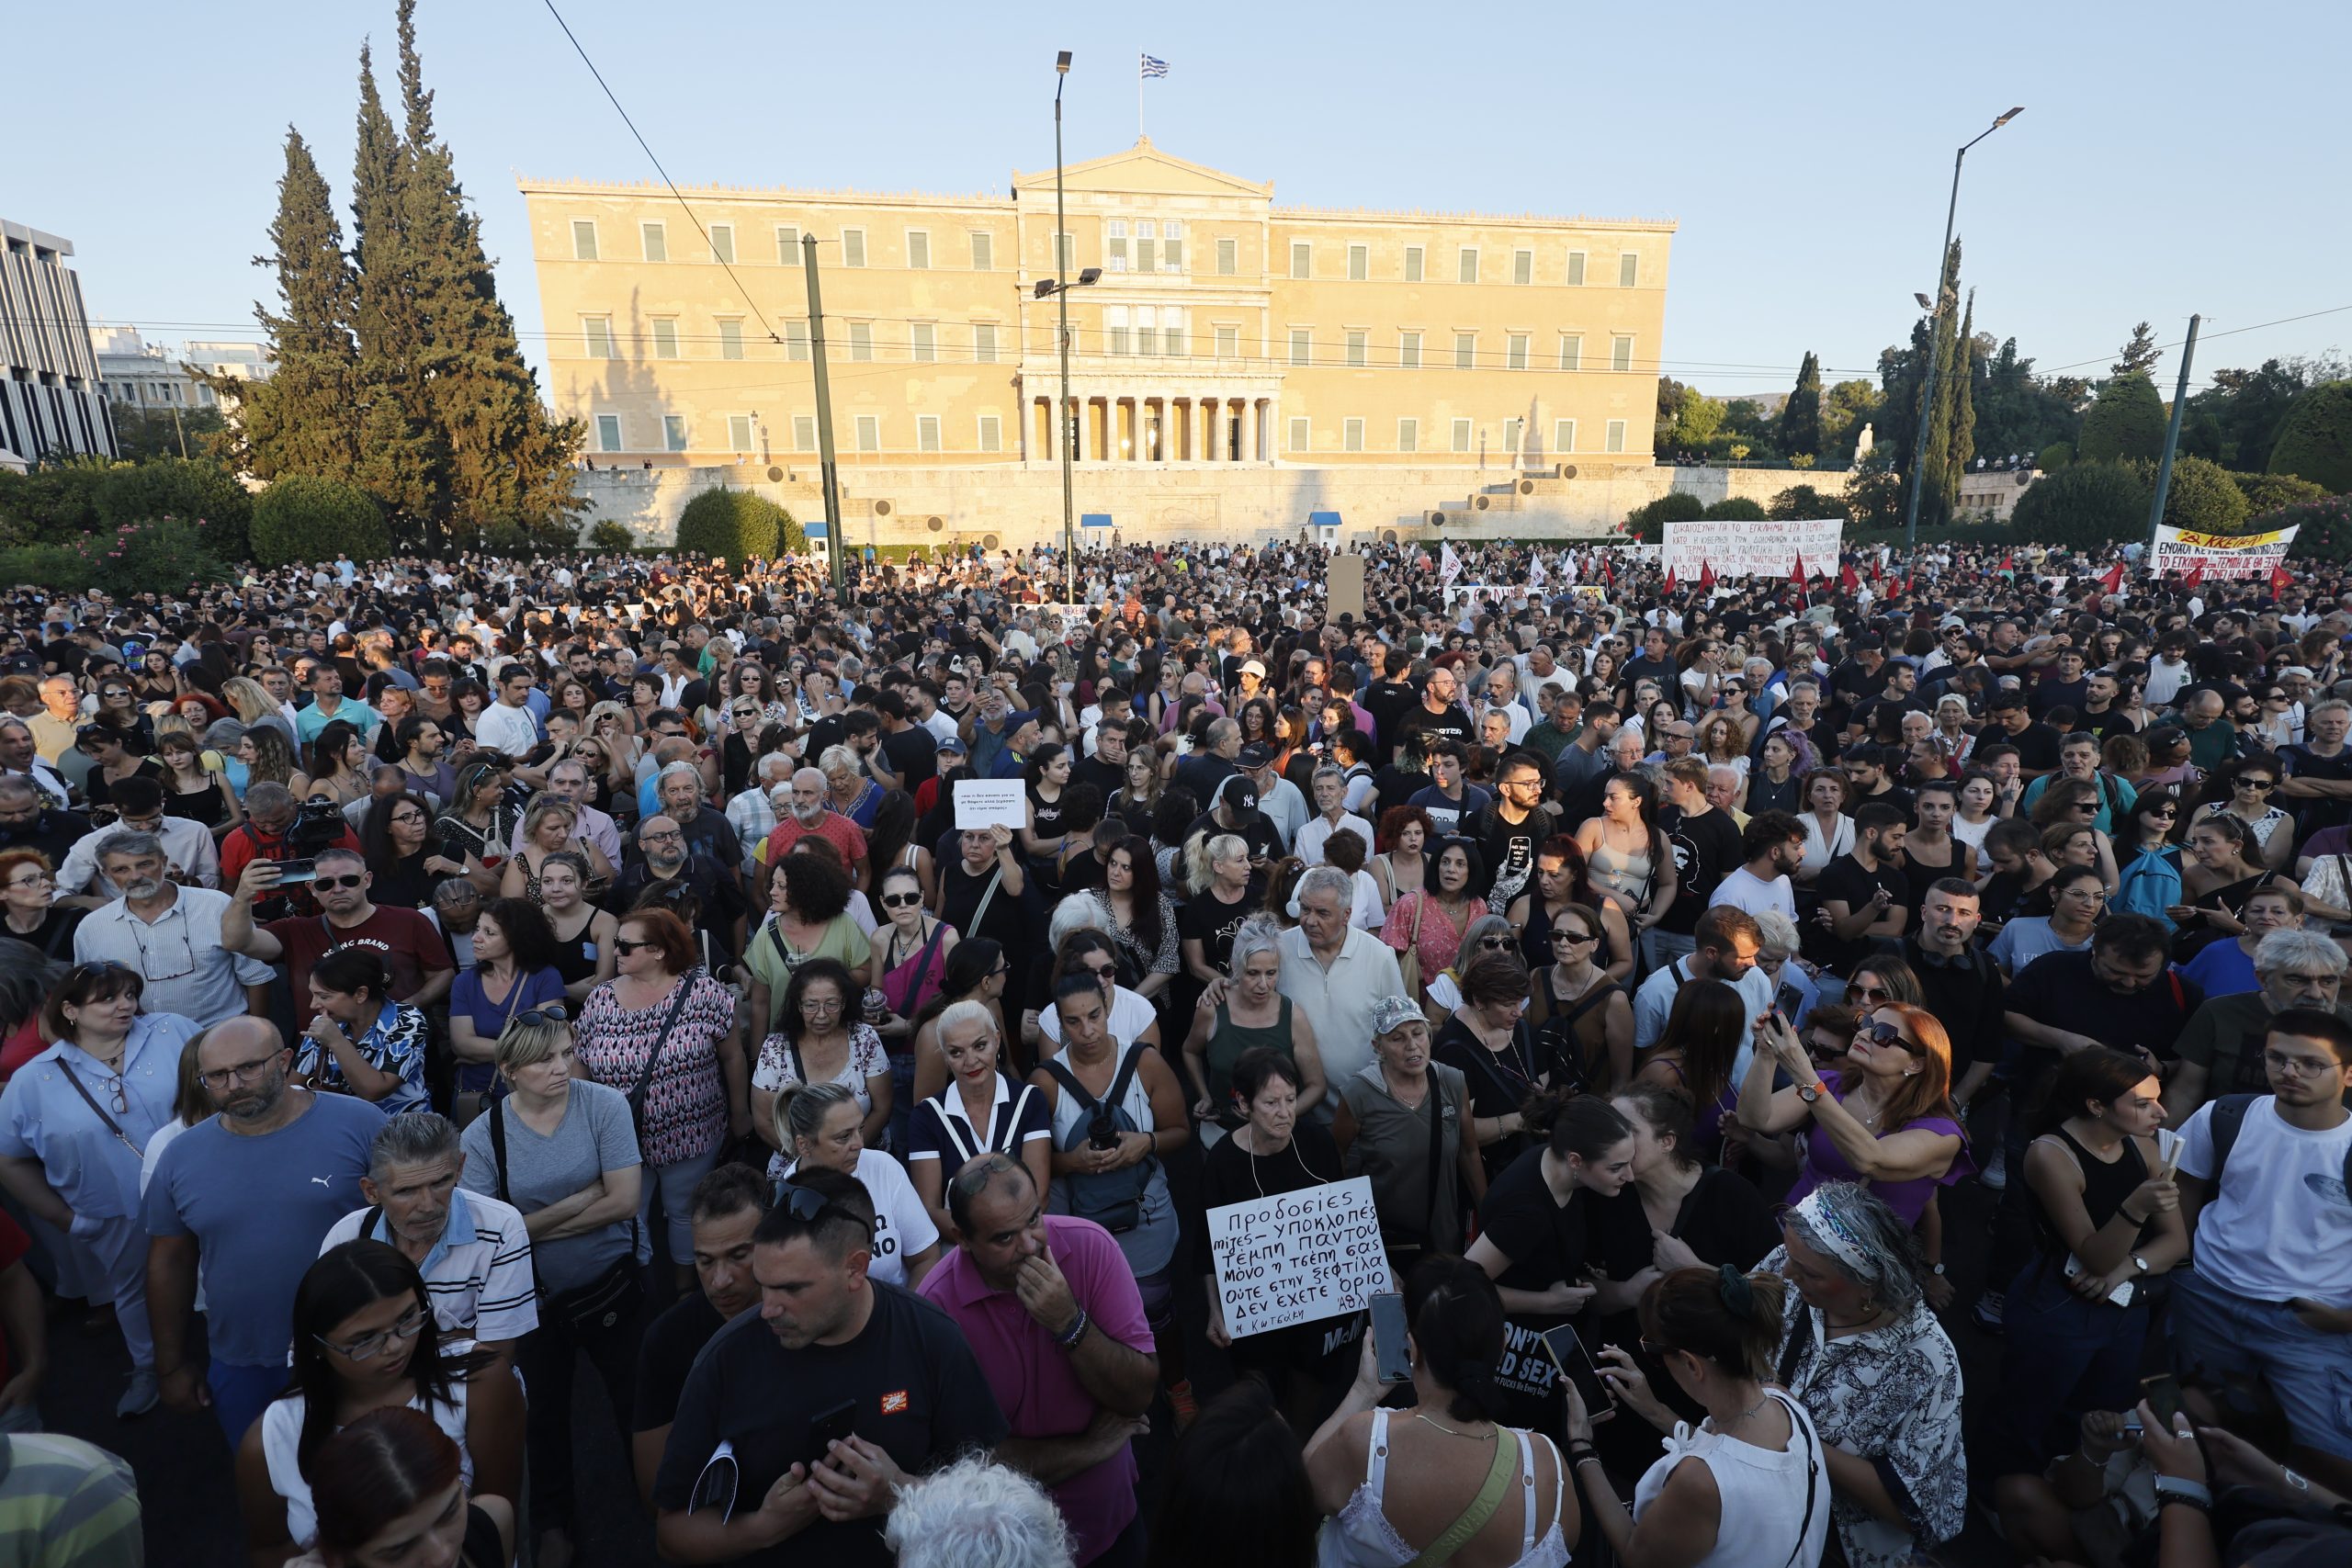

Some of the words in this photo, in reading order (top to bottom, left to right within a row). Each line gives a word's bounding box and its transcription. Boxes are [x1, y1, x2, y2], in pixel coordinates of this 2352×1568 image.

[1673, 524, 1715, 534] ΔΙΚΑΙΟΣΥΝΗ
[1719, 524, 1727, 532] ΓΙΑ
[1732, 524, 1741, 532] ΤΟ
[1749, 523, 1783, 533] ΕΓΚΛΗΜΑ
[1788, 522, 1801, 532] ΣΤΑ
[1673, 536, 1687, 545] ΚΑΤΩ
[1684, 545, 1707, 554] ΤΕΡΜΑ
[2158, 542, 2192, 555] ΕΝΟΧΟΙ
[1243, 794, 1255, 807] NY
[356, 938, 390, 951] BRAND
[1503, 1321, 1543, 1355] ON'T
[1518, 1357, 1559, 1389] SEX
